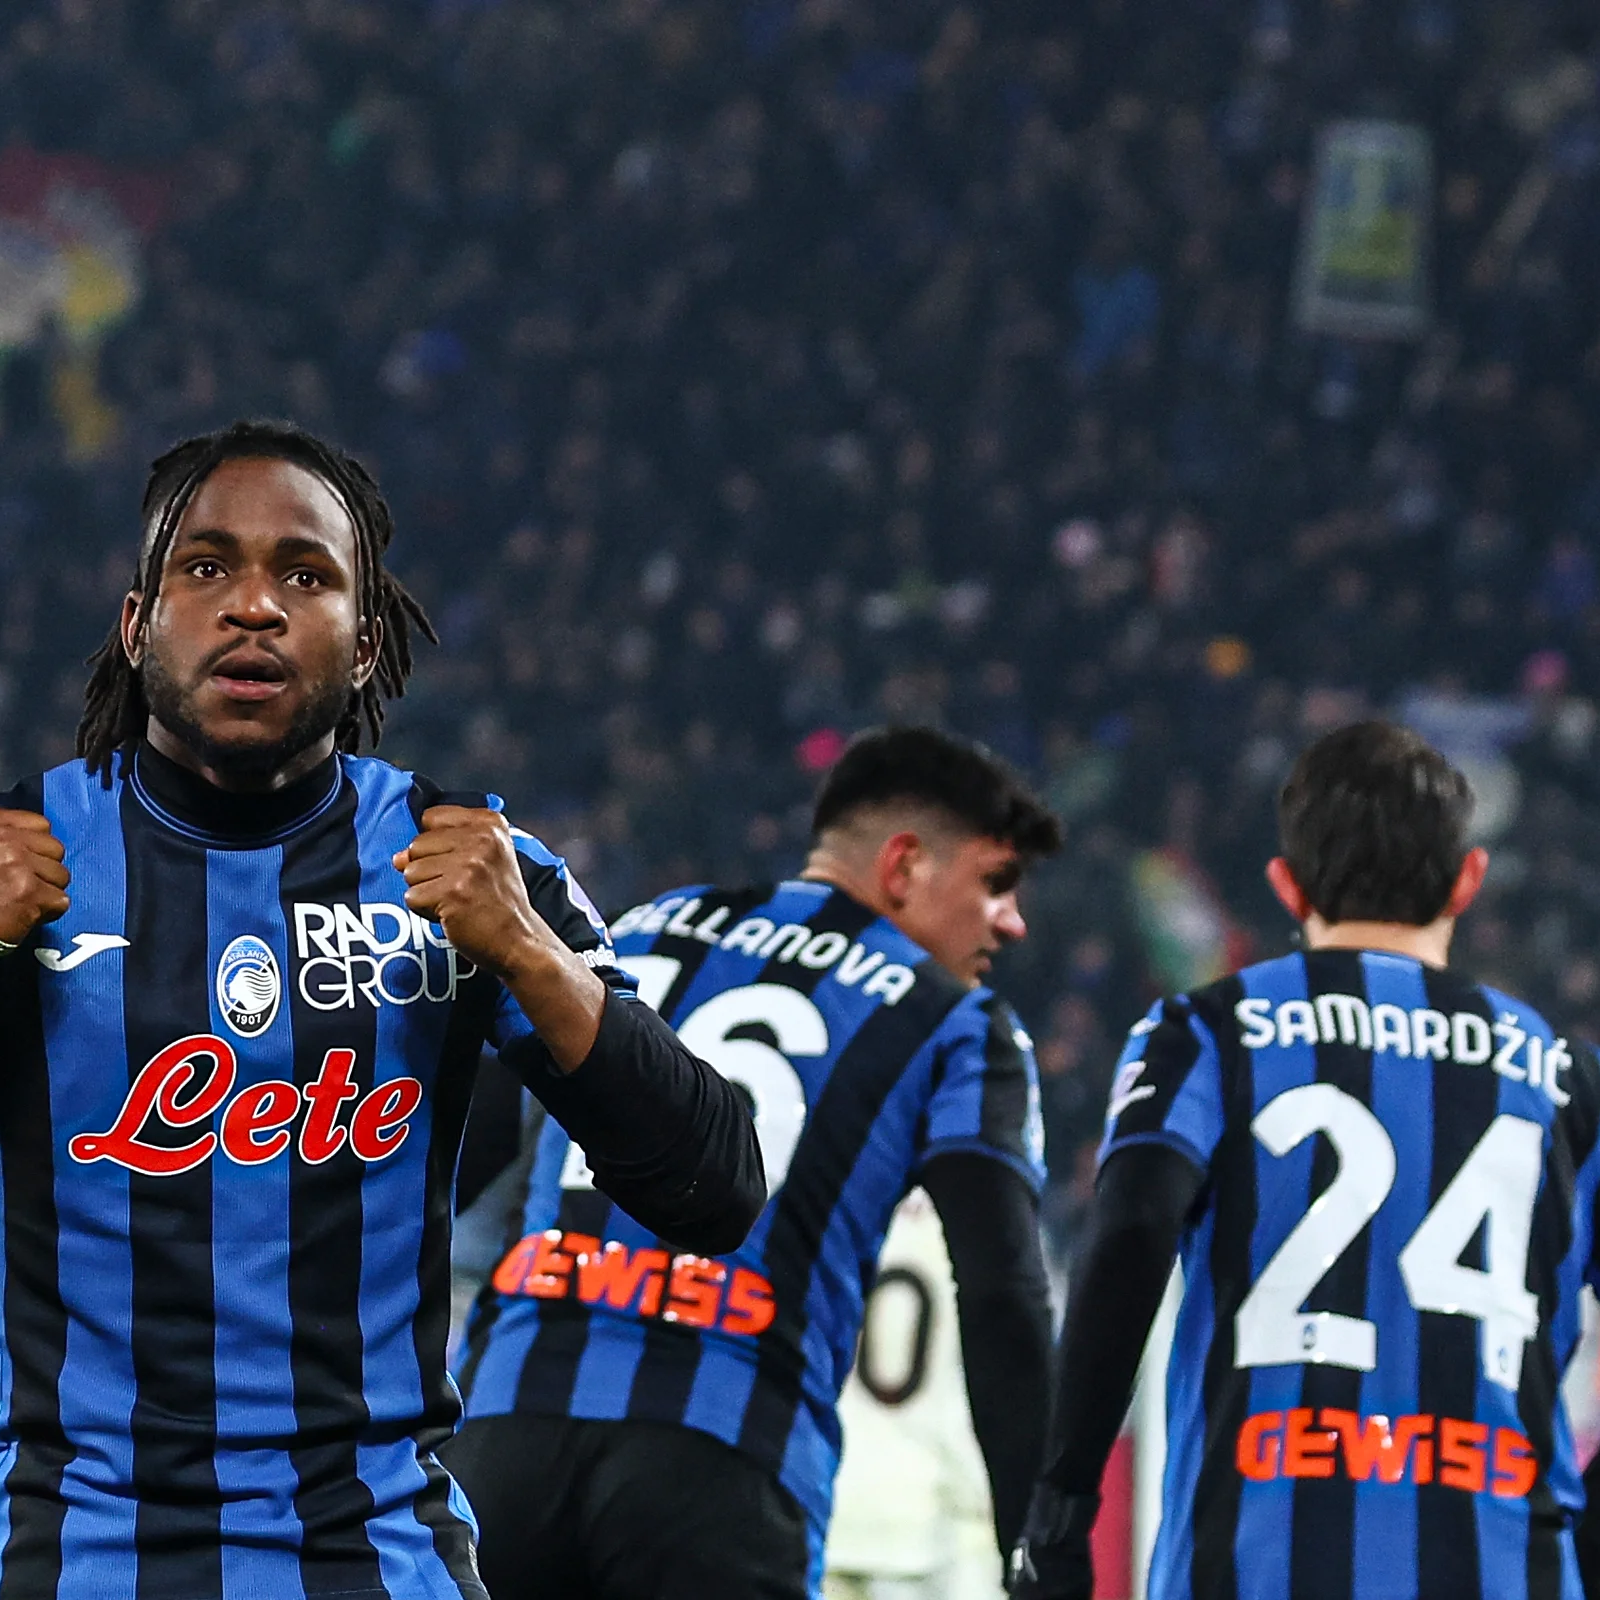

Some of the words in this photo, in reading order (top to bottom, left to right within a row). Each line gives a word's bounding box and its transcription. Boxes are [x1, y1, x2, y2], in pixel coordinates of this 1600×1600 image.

[227, 950, 269, 963] ATALANTA
[298, 950, 479, 1011] GROUP
[608, 895, 916, 1006] BELLANOVA
[236, 1013, 262, 1025] 1907
[68, 1034, 423, 1176] Lete
[1234, 1083, 1543, 1392] 24
